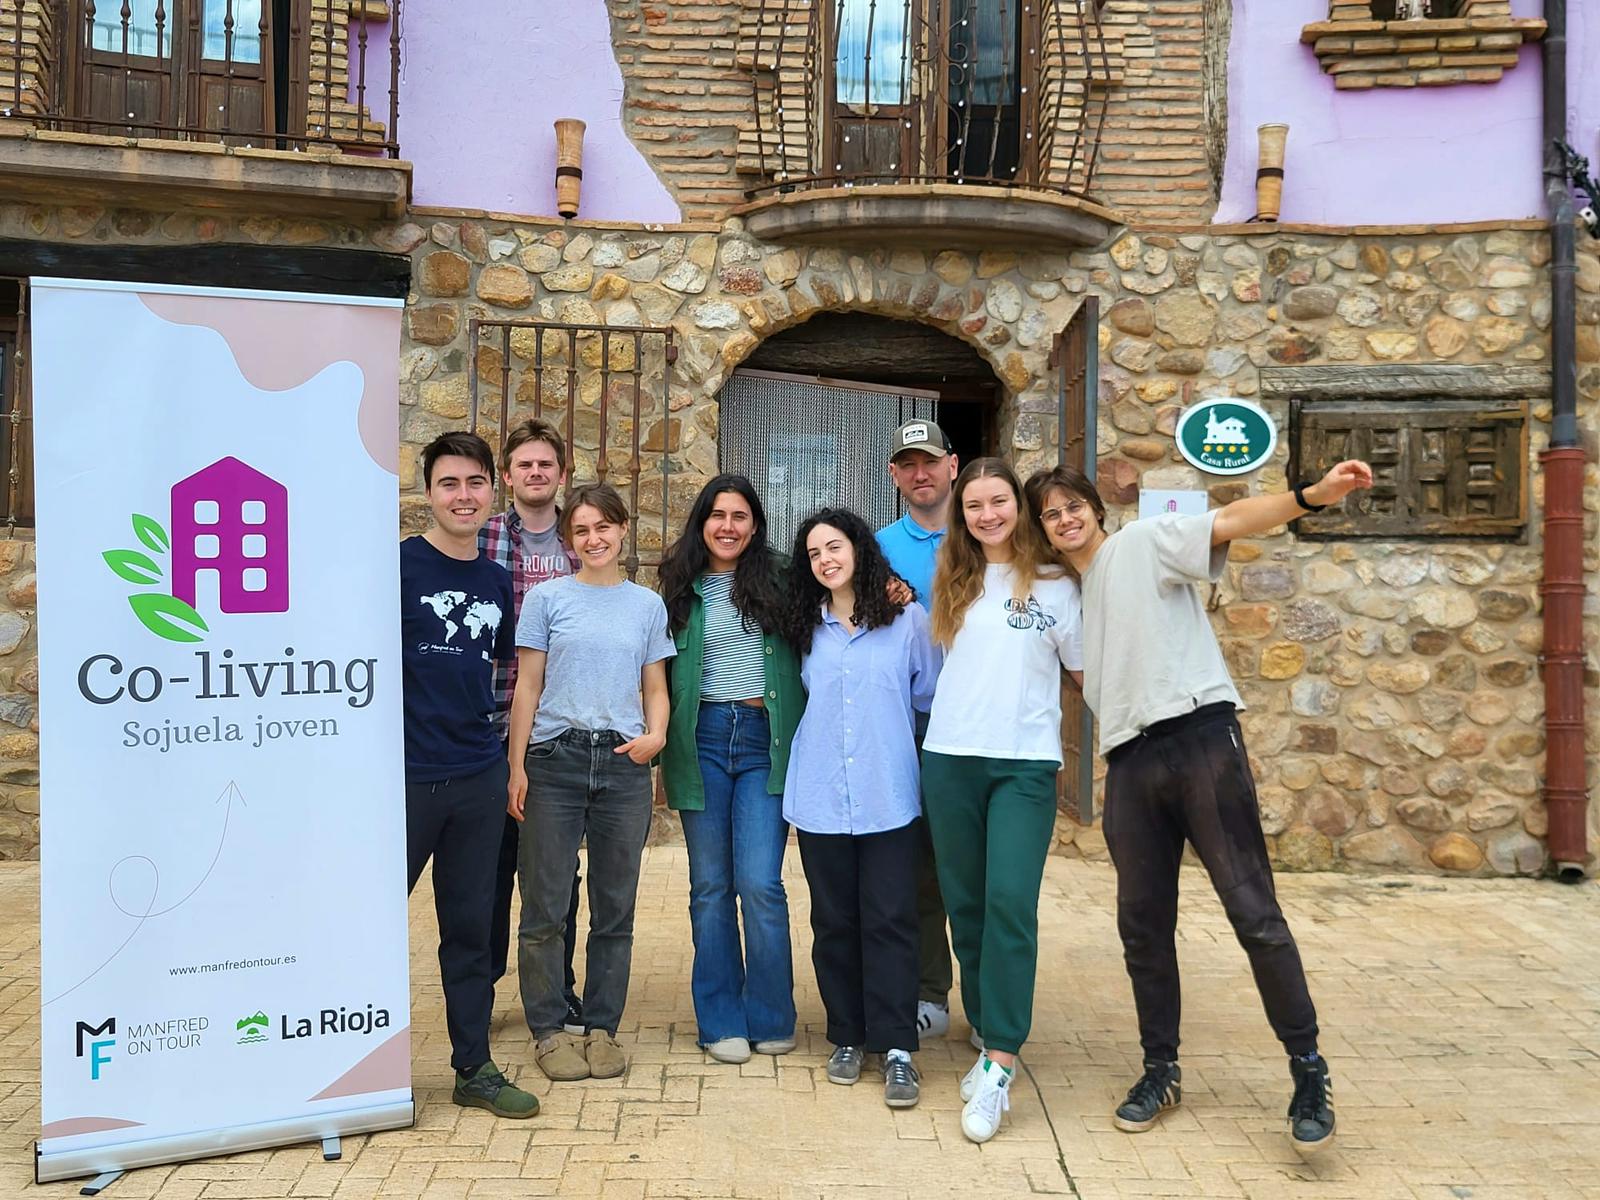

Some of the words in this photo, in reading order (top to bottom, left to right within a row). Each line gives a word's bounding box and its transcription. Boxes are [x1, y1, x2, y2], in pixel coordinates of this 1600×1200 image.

[1200, 452, 1221, 467] Casa
[1224, 453, 1250, 468] Rural
[523, 554, 564, 573] RONTO
[77, 647, 378, 708] Co-living
[122, 716, 244, 753] Sojuela
[252, 714, 340, 748] joven
[169, 954, 297, 976] www.manfredontour.es
[128, 1017, 209, 1039] MANFRED
[281, 1015, 313, 1040] La
[320, 1003, 390, 1035] Rioja
[127, 1039, 152, 1055] ON
[156, 1033, 201, 1051] TOUR
